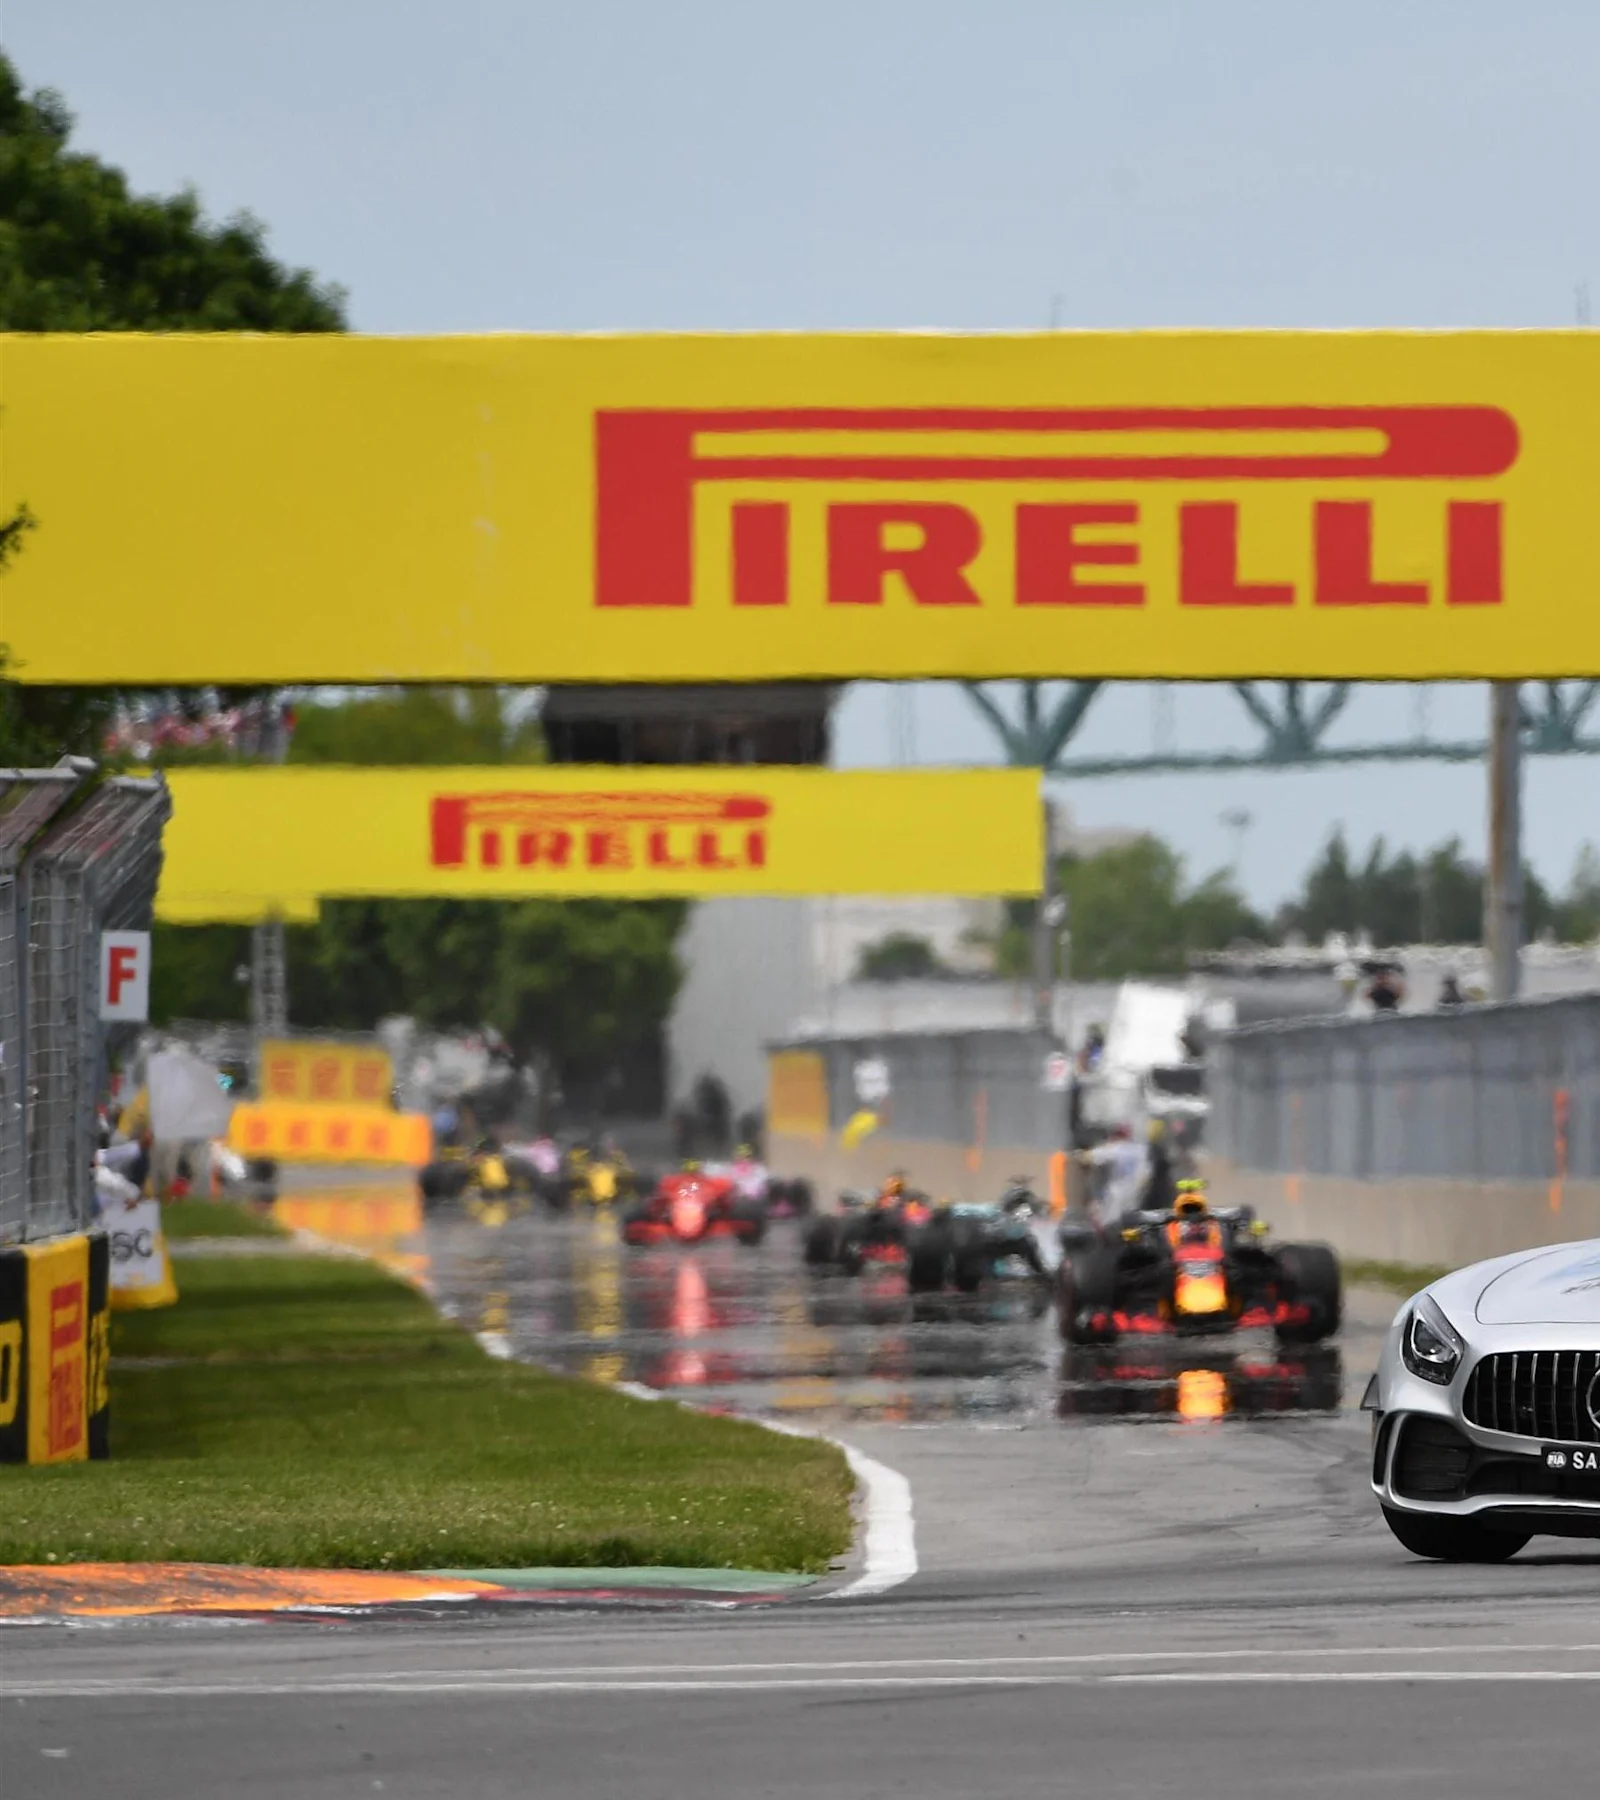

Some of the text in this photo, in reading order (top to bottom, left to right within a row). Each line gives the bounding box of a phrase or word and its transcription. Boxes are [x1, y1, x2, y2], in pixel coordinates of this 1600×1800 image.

[593, 404, 1521, 607] PIRELLI
[430, 792, 772, 868] PIRELLI
[107, 946, 137, 1006] F
[111, 1228, 153, 1262] SC
[1547, 1454, 1565, 1467] FIA
